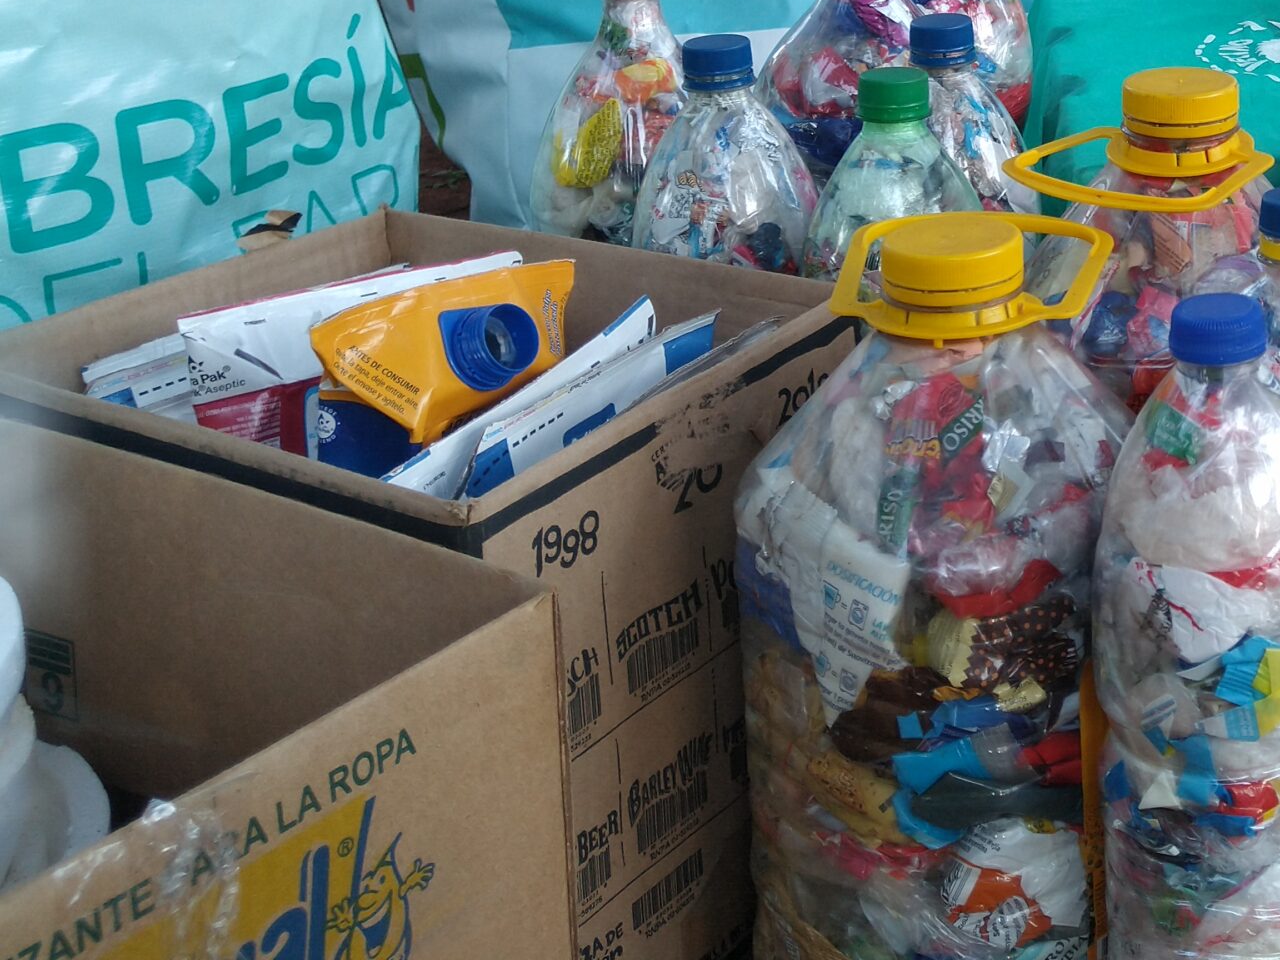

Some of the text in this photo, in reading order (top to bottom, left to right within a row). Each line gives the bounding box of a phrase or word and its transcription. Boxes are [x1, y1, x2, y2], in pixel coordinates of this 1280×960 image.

[205, 378, 246, 396] Aseptic
[354, 378, 378, 395] envase
[370, 360, 383, 371] DE
[381, 368, 421, 396] CONSUMIR
[385, 385, 405, 400] entrar
[532, 509, 600, 578] 1998
[616, 577, 705, 663] SCOTCH
[276, 784, 322, 835] LA
[329, 728, 417, 803] ROPA
[628, 760, 679, 828] BARLEY
[577, 809, 620, 866] BEER
